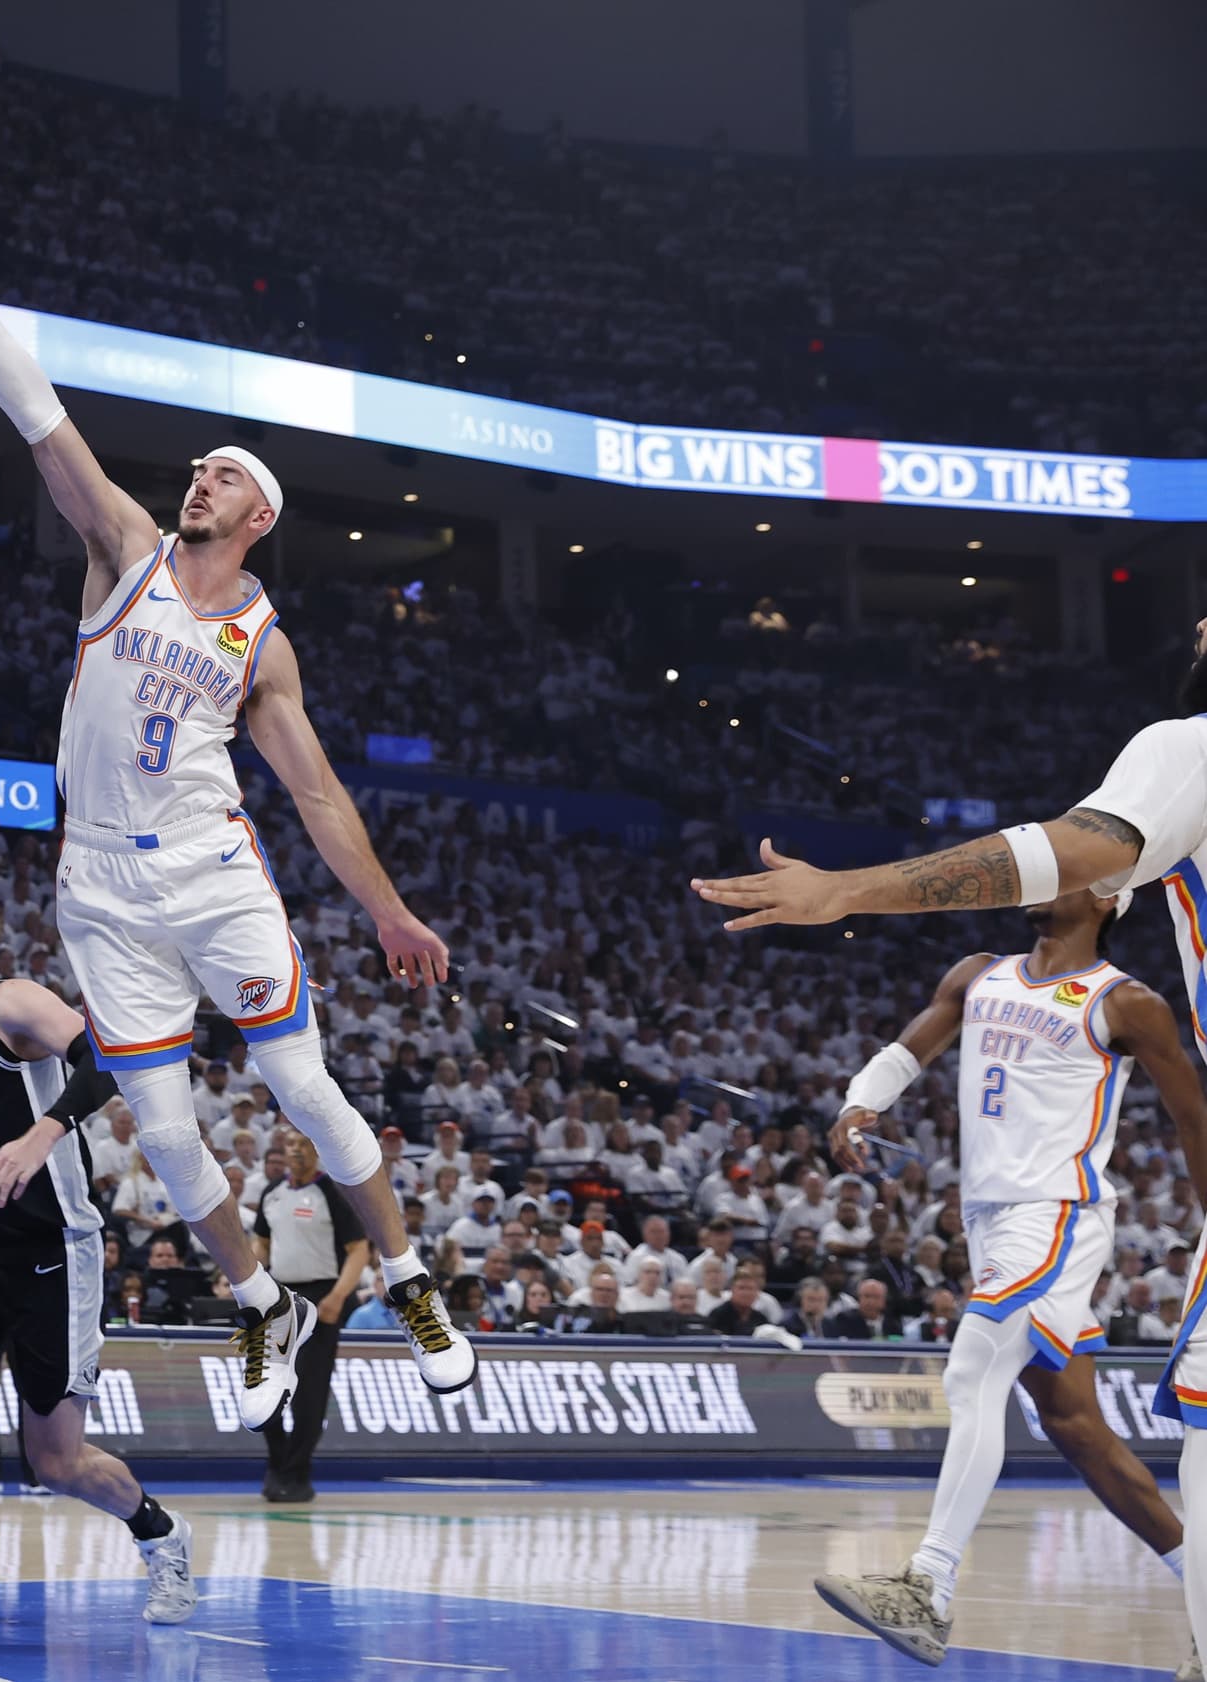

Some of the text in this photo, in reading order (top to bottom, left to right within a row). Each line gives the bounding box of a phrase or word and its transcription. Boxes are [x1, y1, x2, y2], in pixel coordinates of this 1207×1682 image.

[595, 427, 816, 489] BIG WINS
[983, 458, 1131, 509] TIMES
[112, 626, 242, 712] OKLAHOMA
[135, 671, 201, 722] CITY
[136, 712, 178, 776] 9
[979, 1027, 1033, 1064] CITY
[978, 1062, 1007, 1120] 2
[330, 1357, 441, 1434] YOUR
[609, 1361, 758, 1435] STREAK
[848, 1386, 889, 1412] PLAY
